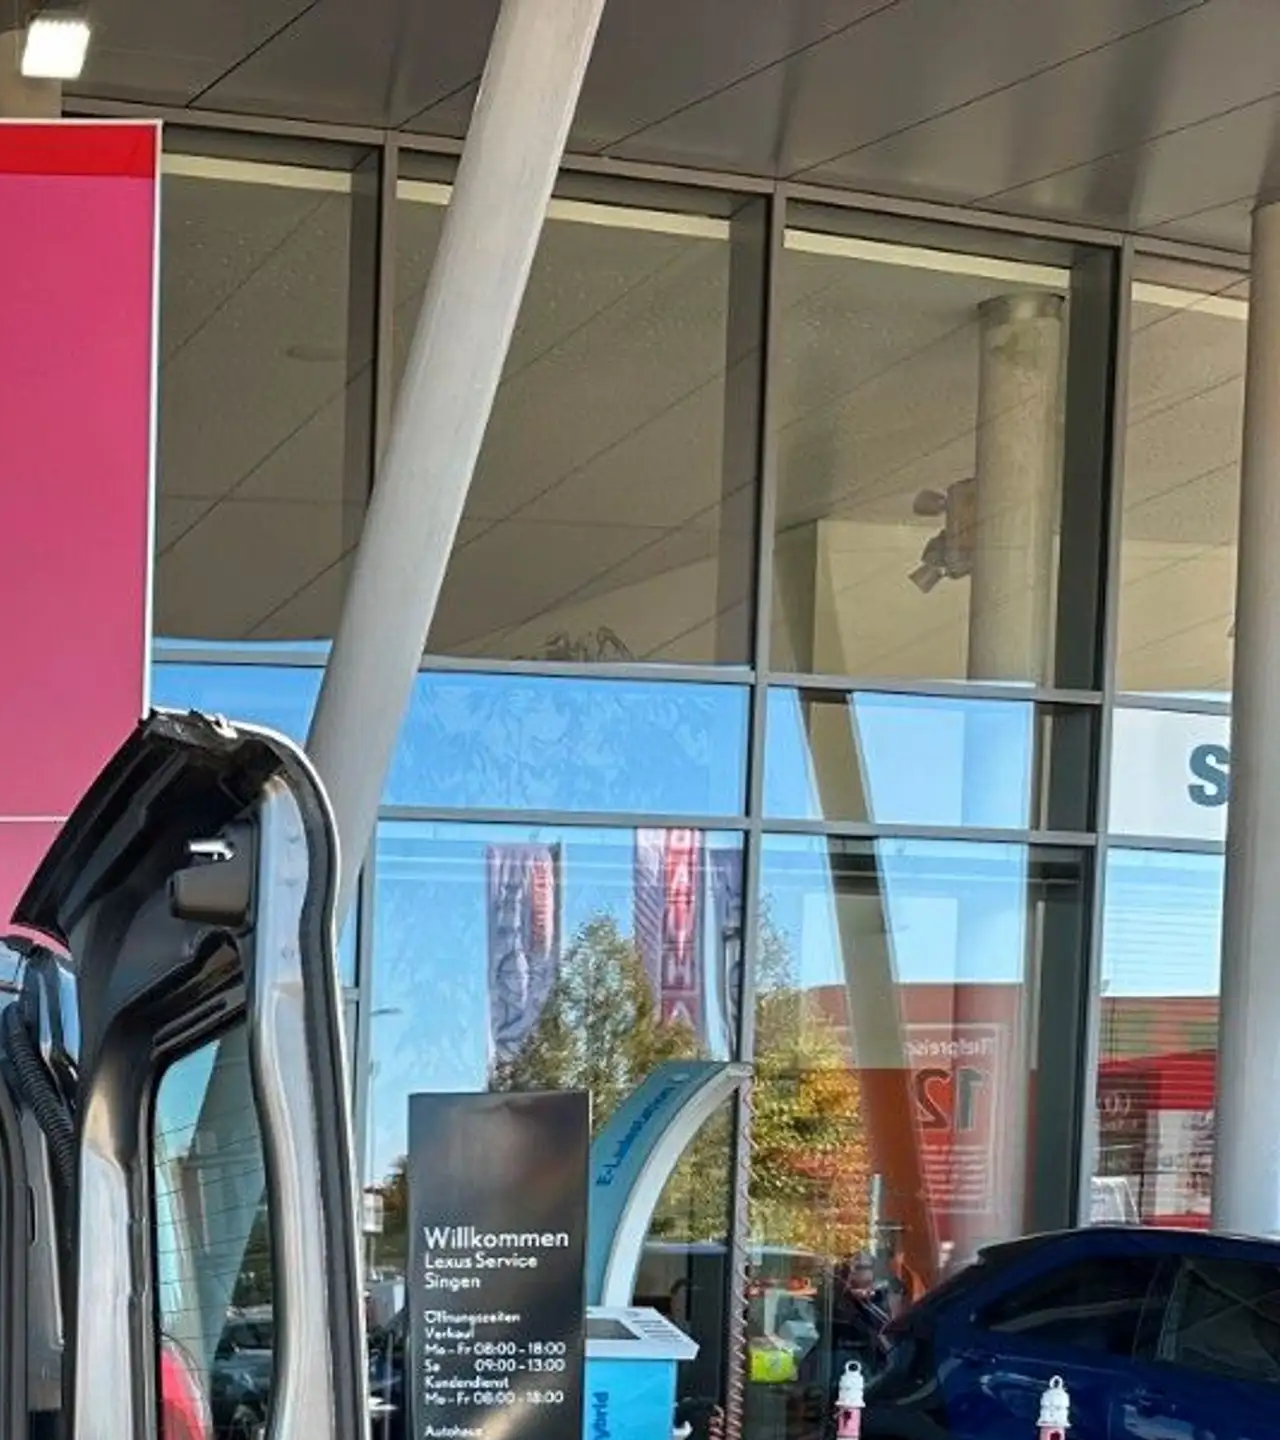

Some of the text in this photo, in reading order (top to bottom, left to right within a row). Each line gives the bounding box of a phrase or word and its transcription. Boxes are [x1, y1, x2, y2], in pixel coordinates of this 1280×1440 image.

[424, 1226, 569, 1249] Willkommen
[424, 1251, 538, 1269] Lexus Service
[424, 1272, 481, 1292] Singen
[424, 1343, 446, 1355] Mo
[456, 1342, 471, 1355] Fr
[528, 1342, 566, 1355] 18:00
[474, 1359, 516, 1372] 09:00
[528, 1359, 566, 1372] 13:00
[424, 1392, 446, 1405] Mo
[456, 1392, 470, 1405] Fr
